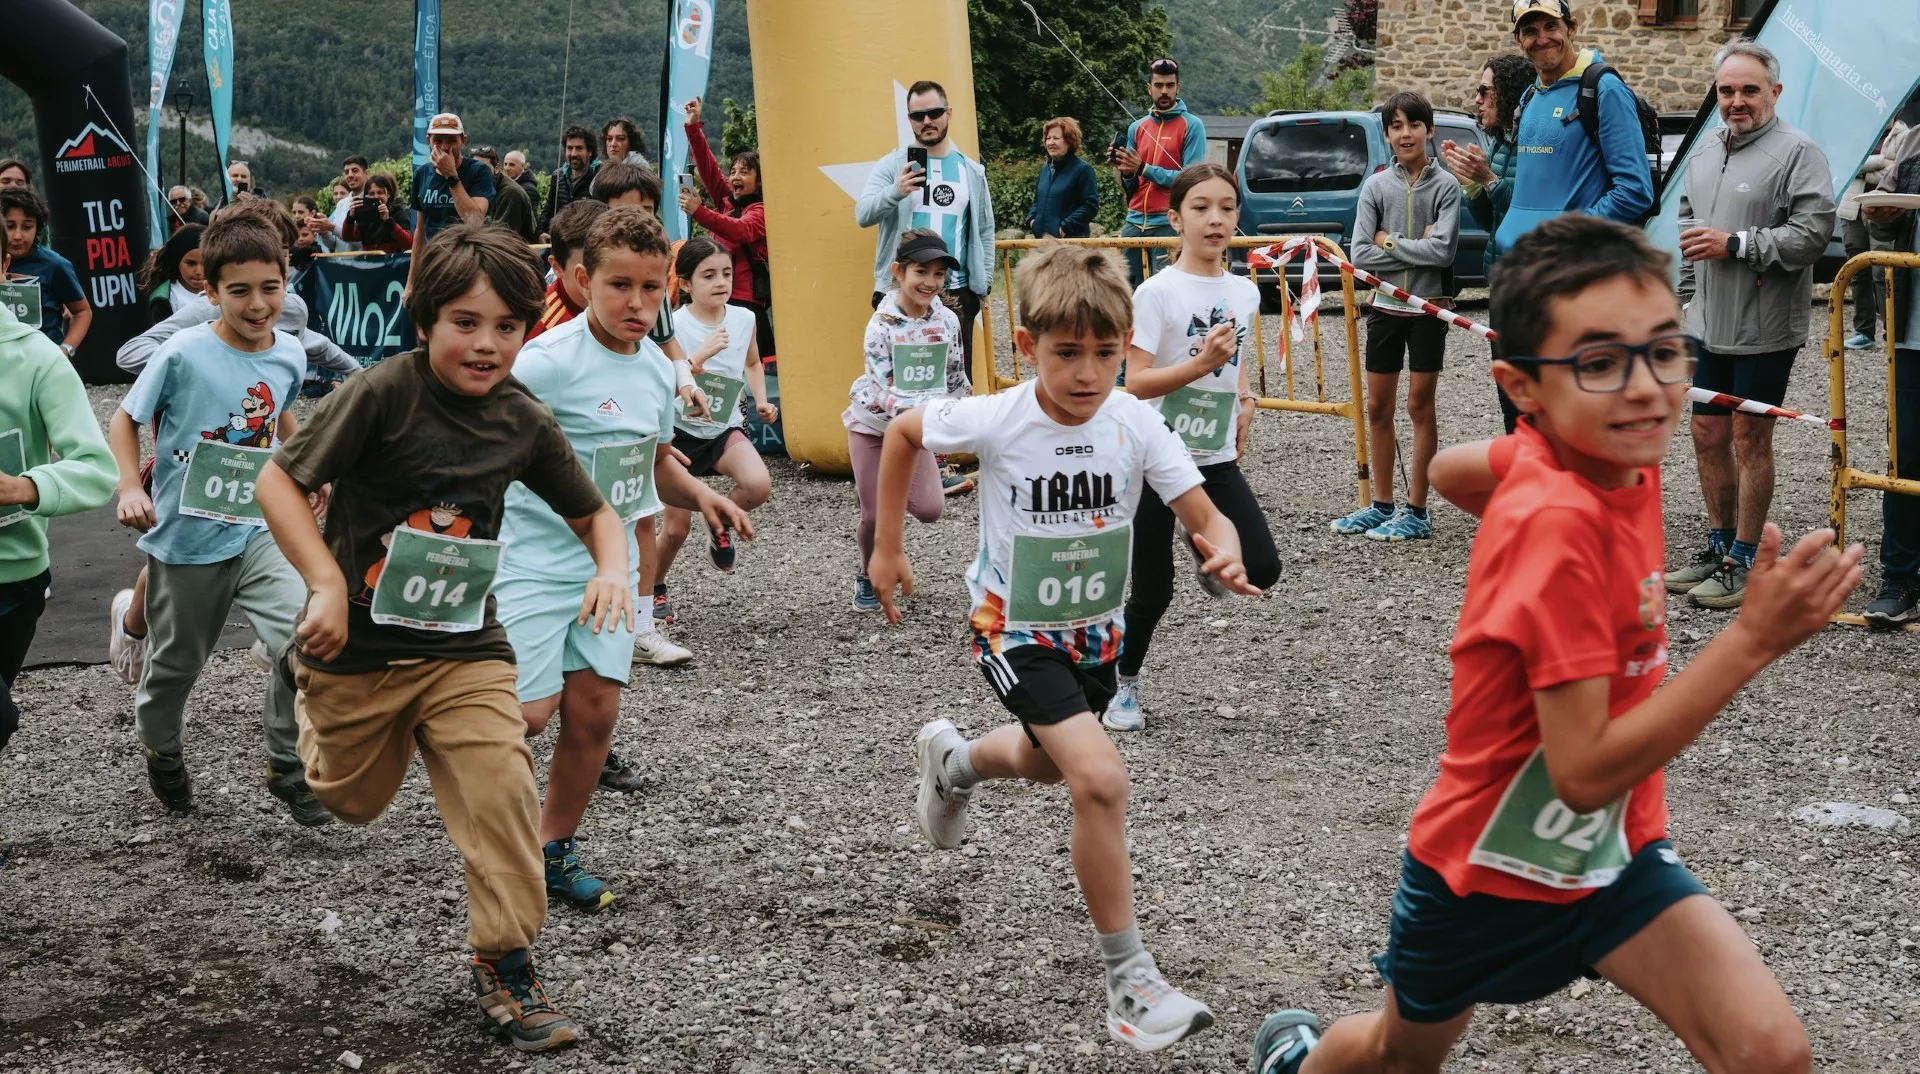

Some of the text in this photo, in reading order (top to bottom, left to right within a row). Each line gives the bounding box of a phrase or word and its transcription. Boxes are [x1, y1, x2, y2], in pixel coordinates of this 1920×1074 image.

[208, 8, 219, 51] CAJA
[1782, 4, 1881, 99] huescalamagia.es
[55, 157, 107, 173] PERIMETRAIL
[1526, 146, 1554, 154] THOUSAND
[82, 198, 125, 233] TLC
[86, 235, 132, 271] PDA
[90, 272, 137, 308] UPN
[327, 280, 404, 347] Mo2
[903, 364, 936, 382] 038
[1173, 412, 1218, 439] 004
[204, 475, 256, 505] 013
[610, 473, 644, 506] 032
[1024, 470, 1118, 511] TRAIL
[1032, 513, 1068, 525] VALLE
[1073, 511, 1086, 522] DE
[1051, 547, 1101, 562] PERIMETRAIL
[1065, 560, 1087, 572] KIDS
[402, 575, 469, 607] 014
[1038, 570, 1107, 607] 016
